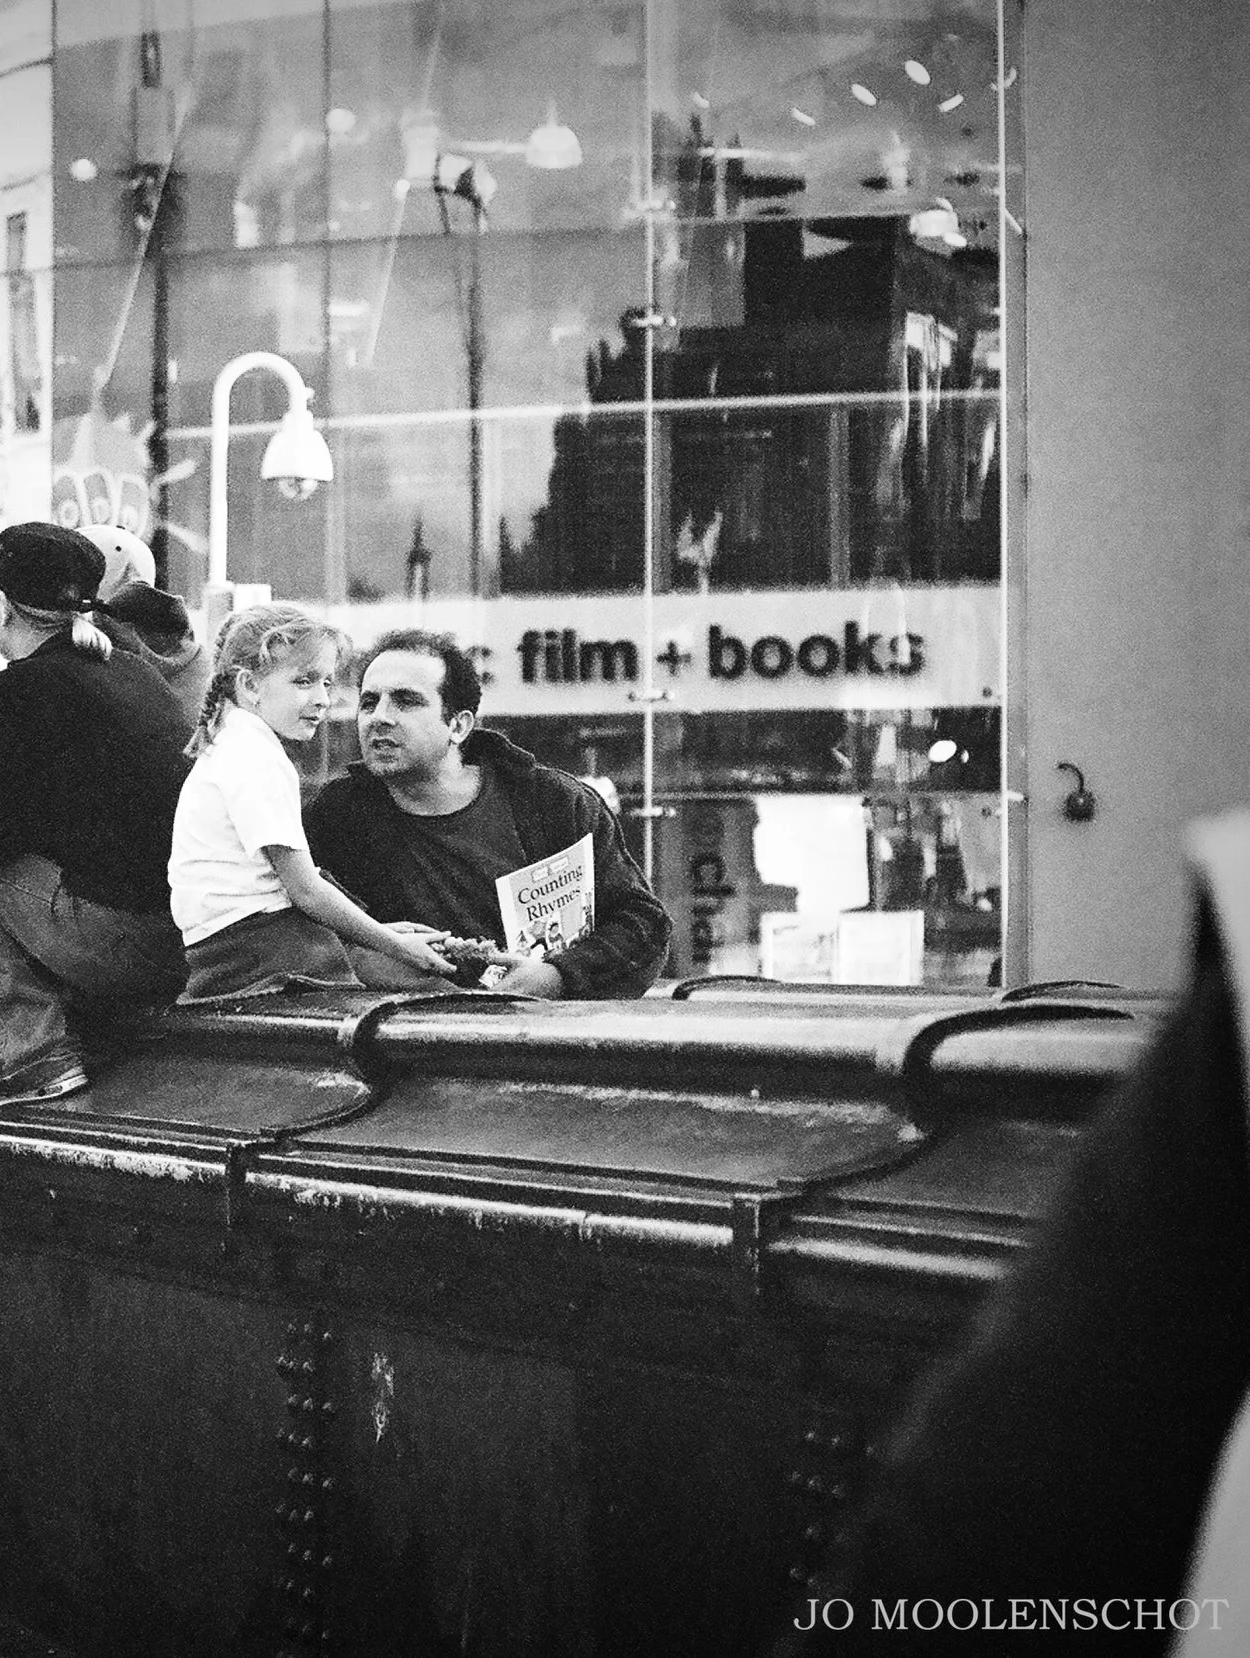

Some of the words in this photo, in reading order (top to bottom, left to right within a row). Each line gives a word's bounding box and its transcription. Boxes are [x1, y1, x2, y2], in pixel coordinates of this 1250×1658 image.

[517, 628, 639, 684] film
[708, 619, 926, 682] books
[517, 865, 583, 905] Counting
